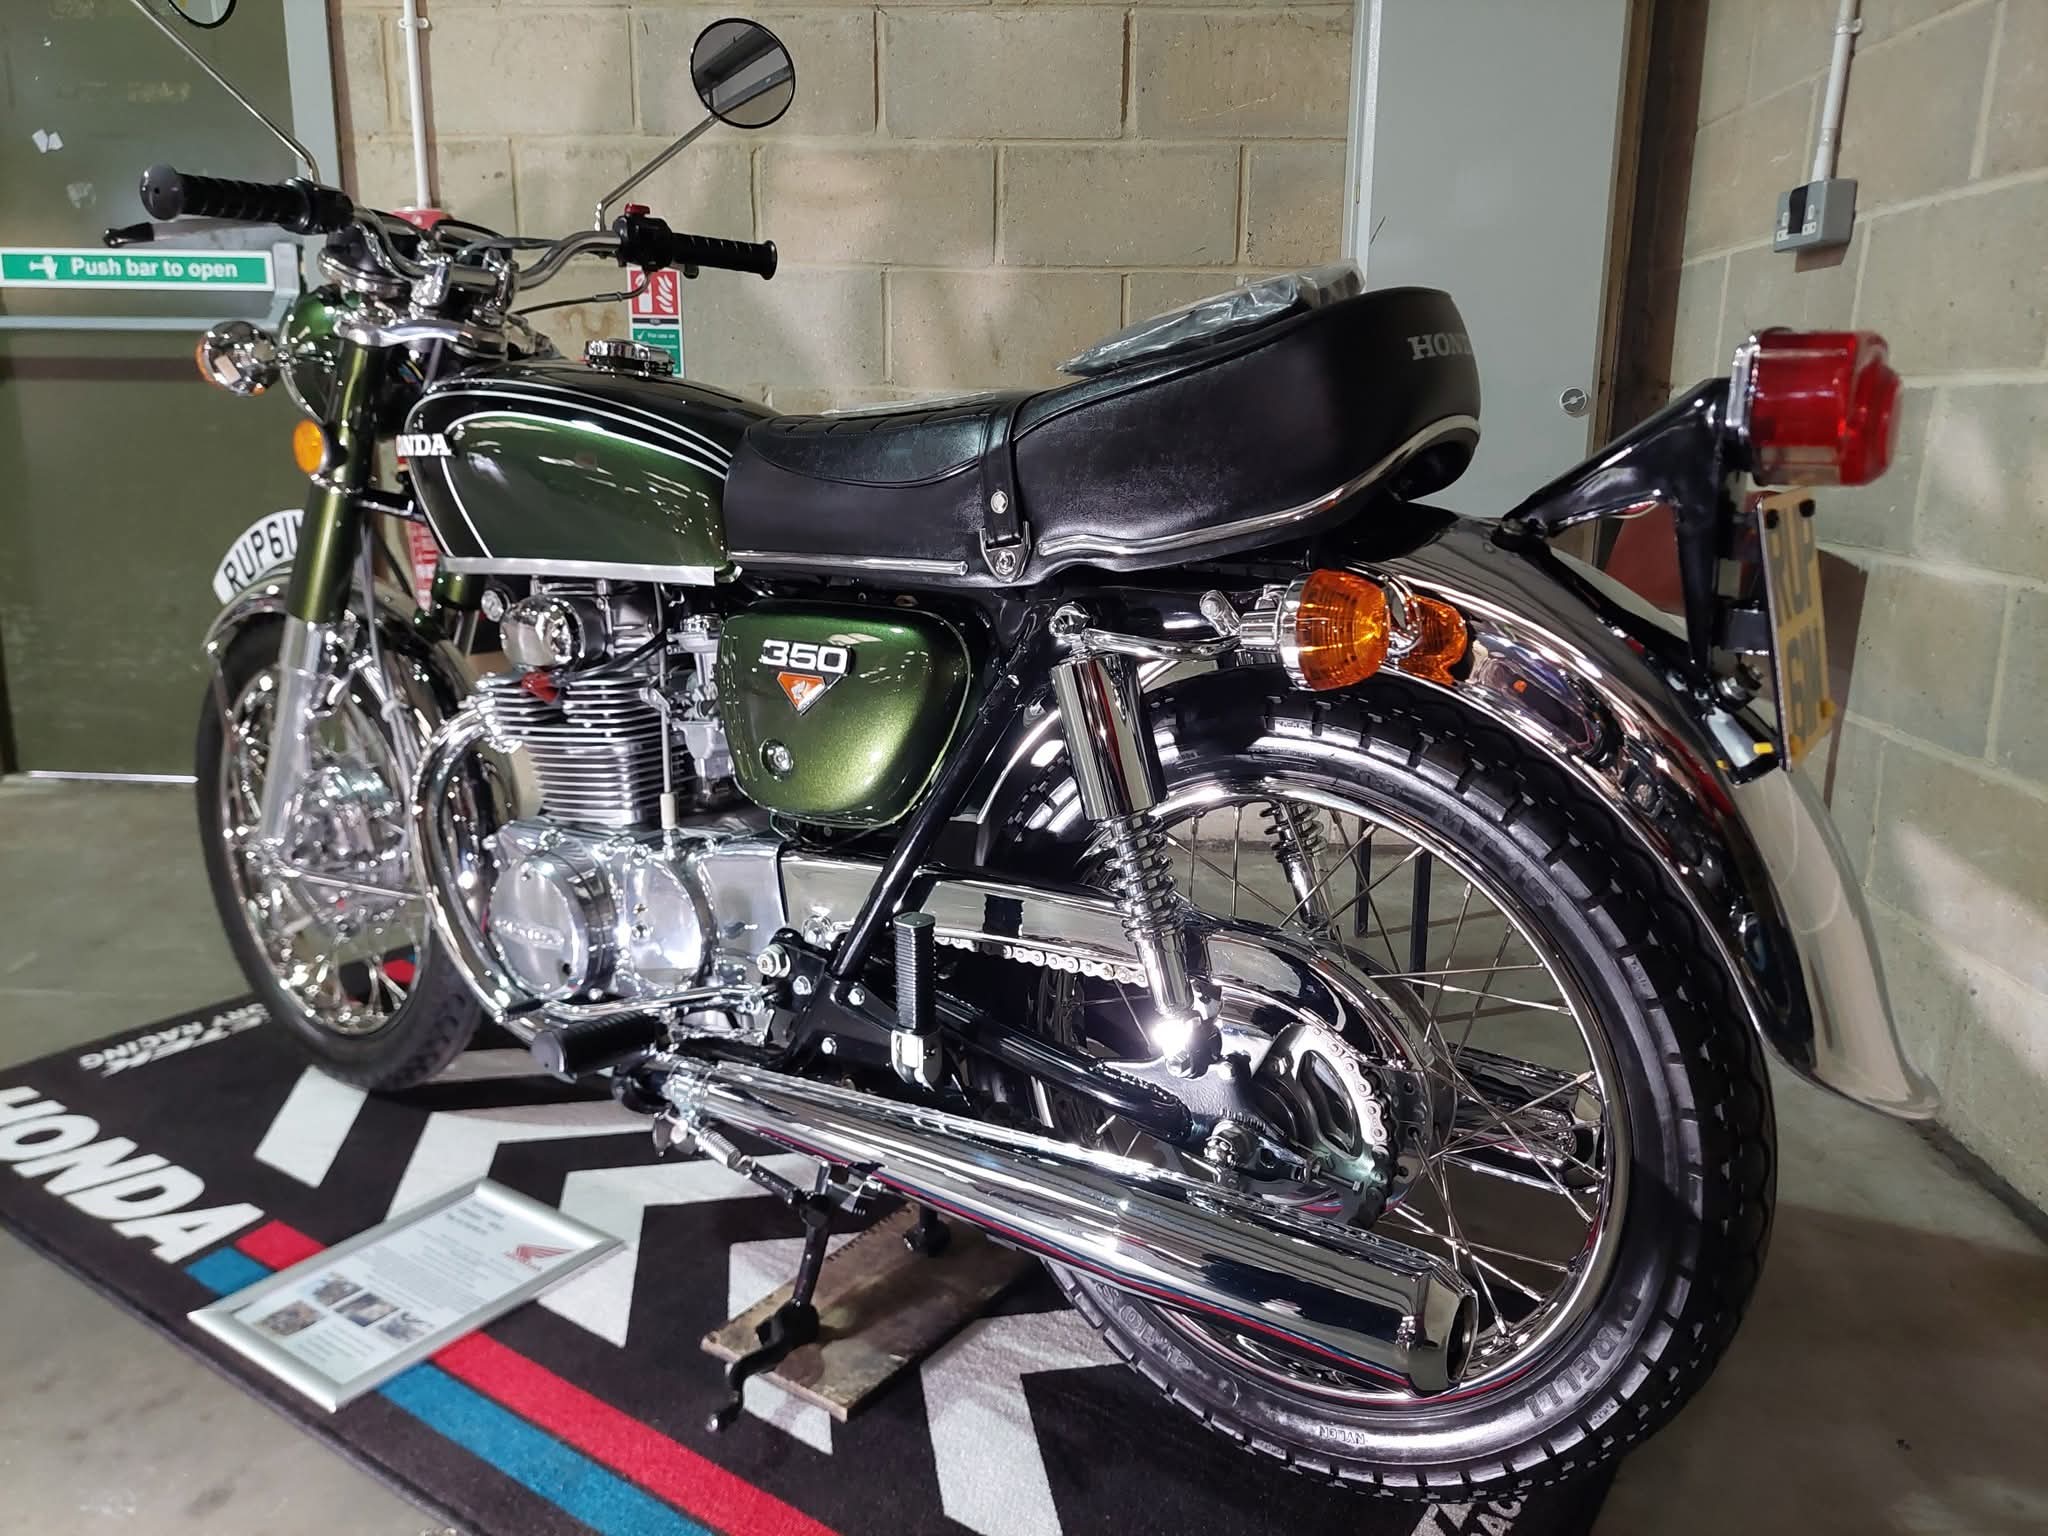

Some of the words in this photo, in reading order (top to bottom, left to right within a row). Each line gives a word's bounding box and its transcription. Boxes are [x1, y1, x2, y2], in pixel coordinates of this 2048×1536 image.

[70, 257, 116, 277] Push
[125, 258, 157, 277] bar
[162, 260, 183, 278] to
[187, 261, 239, 281] open
[1407, 332, 1472, 361] HON
[396, 434, 452, 457] NDA
[761, 638, 849, 674] 350
[1525, 1293, 1642, 1420] PIRELLI
